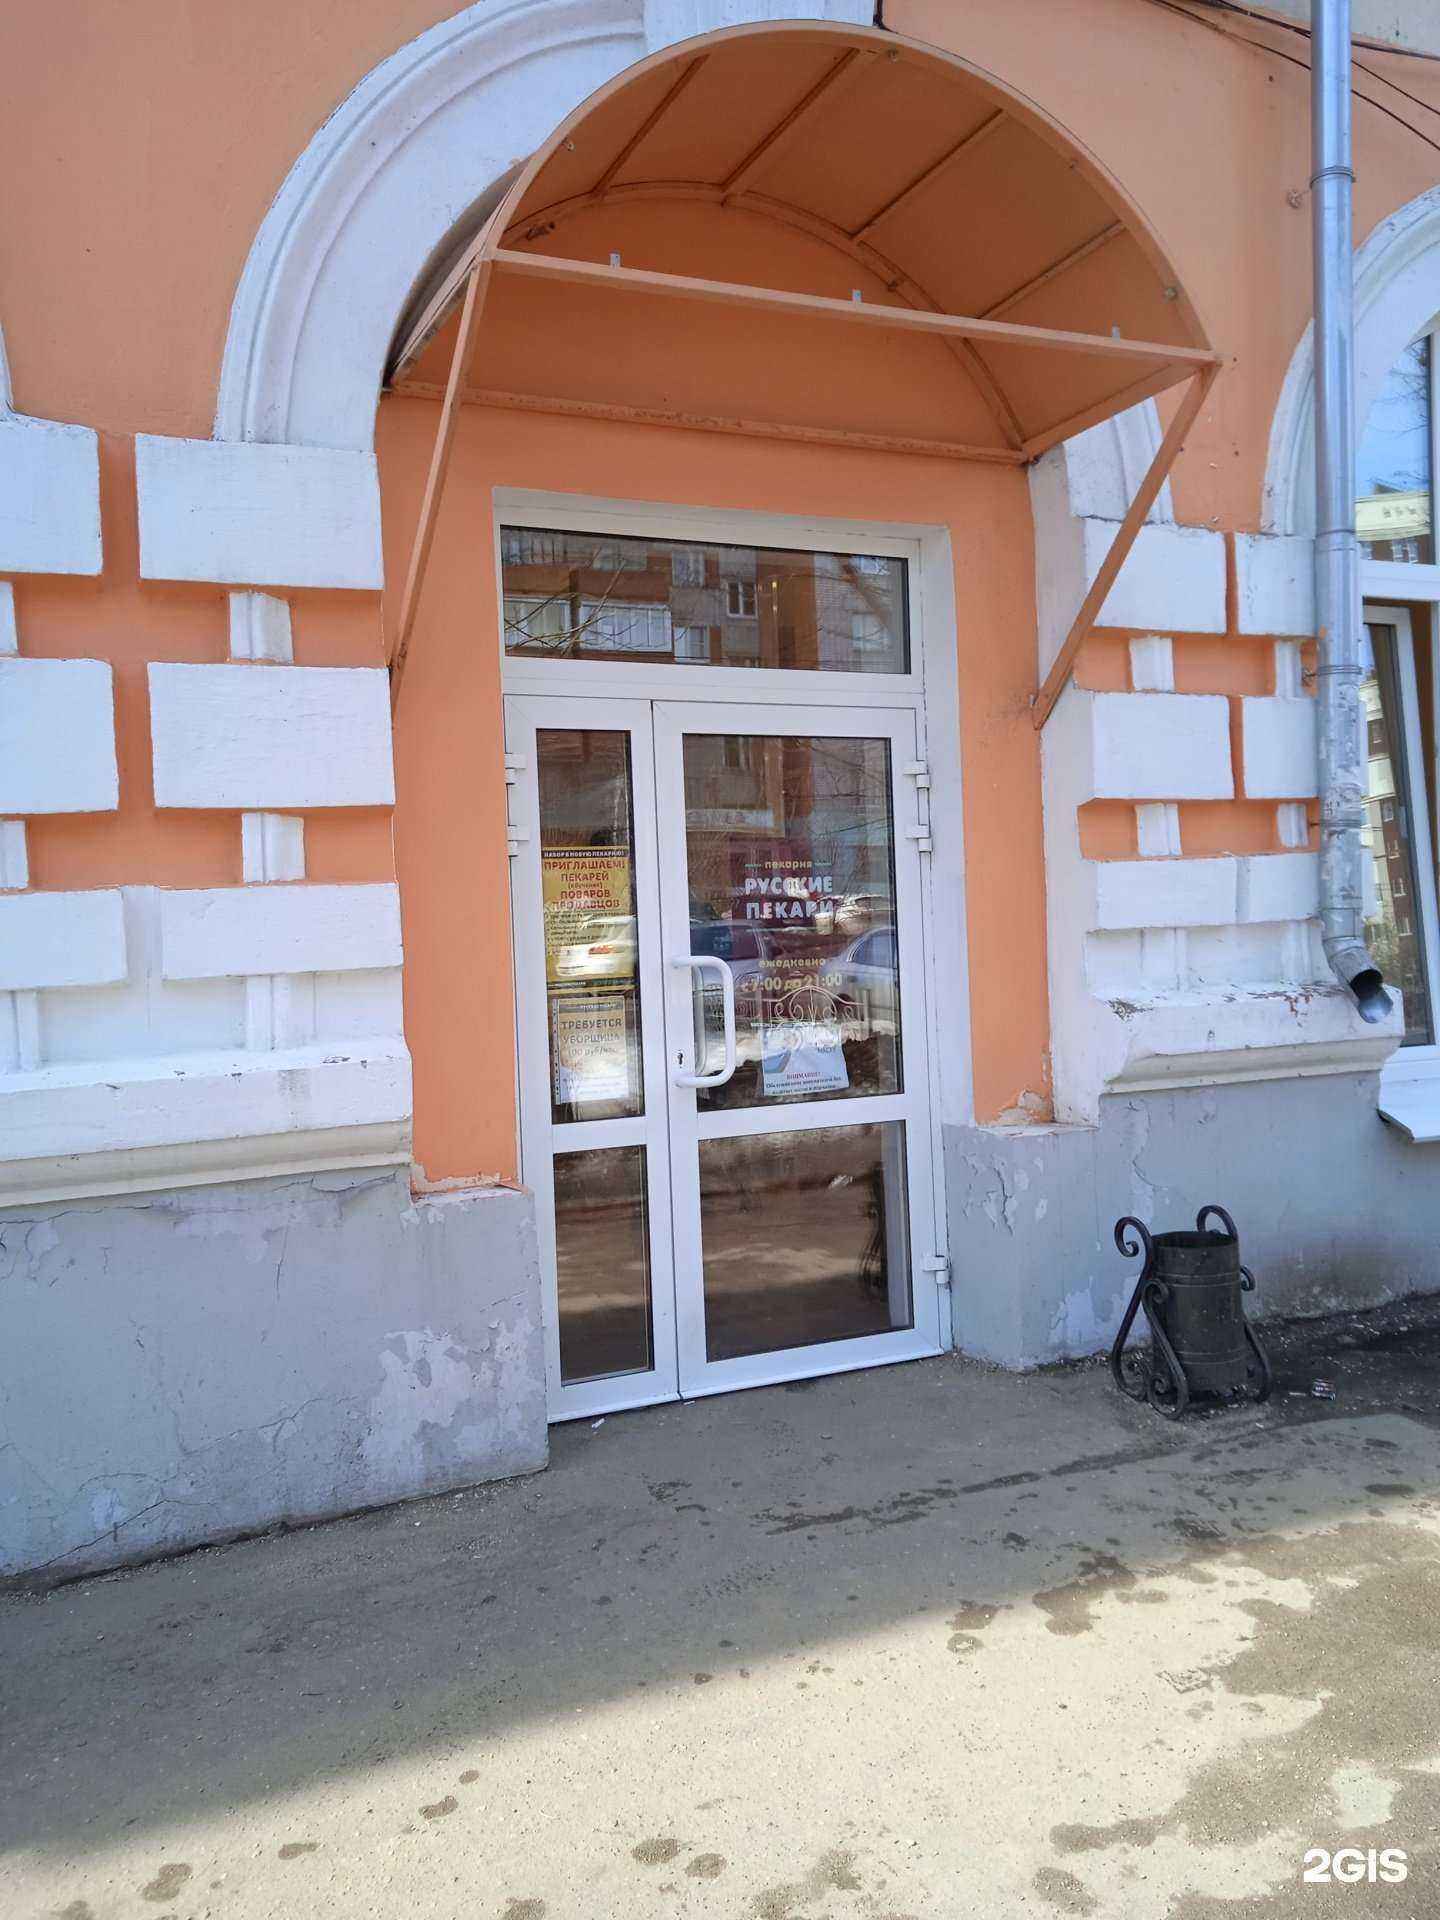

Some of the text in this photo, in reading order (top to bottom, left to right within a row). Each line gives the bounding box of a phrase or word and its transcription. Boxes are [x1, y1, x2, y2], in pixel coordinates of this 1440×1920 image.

[544, 860, 625, 871] ПРИГЛАШАЕМ!
[764, 860, 813, 871] пекарня
[561, 871, 609, 882] ПЕКАРЕЙ
[744, 875, 833, 896] РУССКИЕ
[560, 889, 611, 900] ПОВАРОВ
[552, 899, 621, 911] ПРОДАВЦОВ
[746, 901, 833, 921] ПЕКАРИ
[758, 957, 827, 970] ежедневно
[560, 1018, 623, 1030] ТРЕБУЕТСЯ
